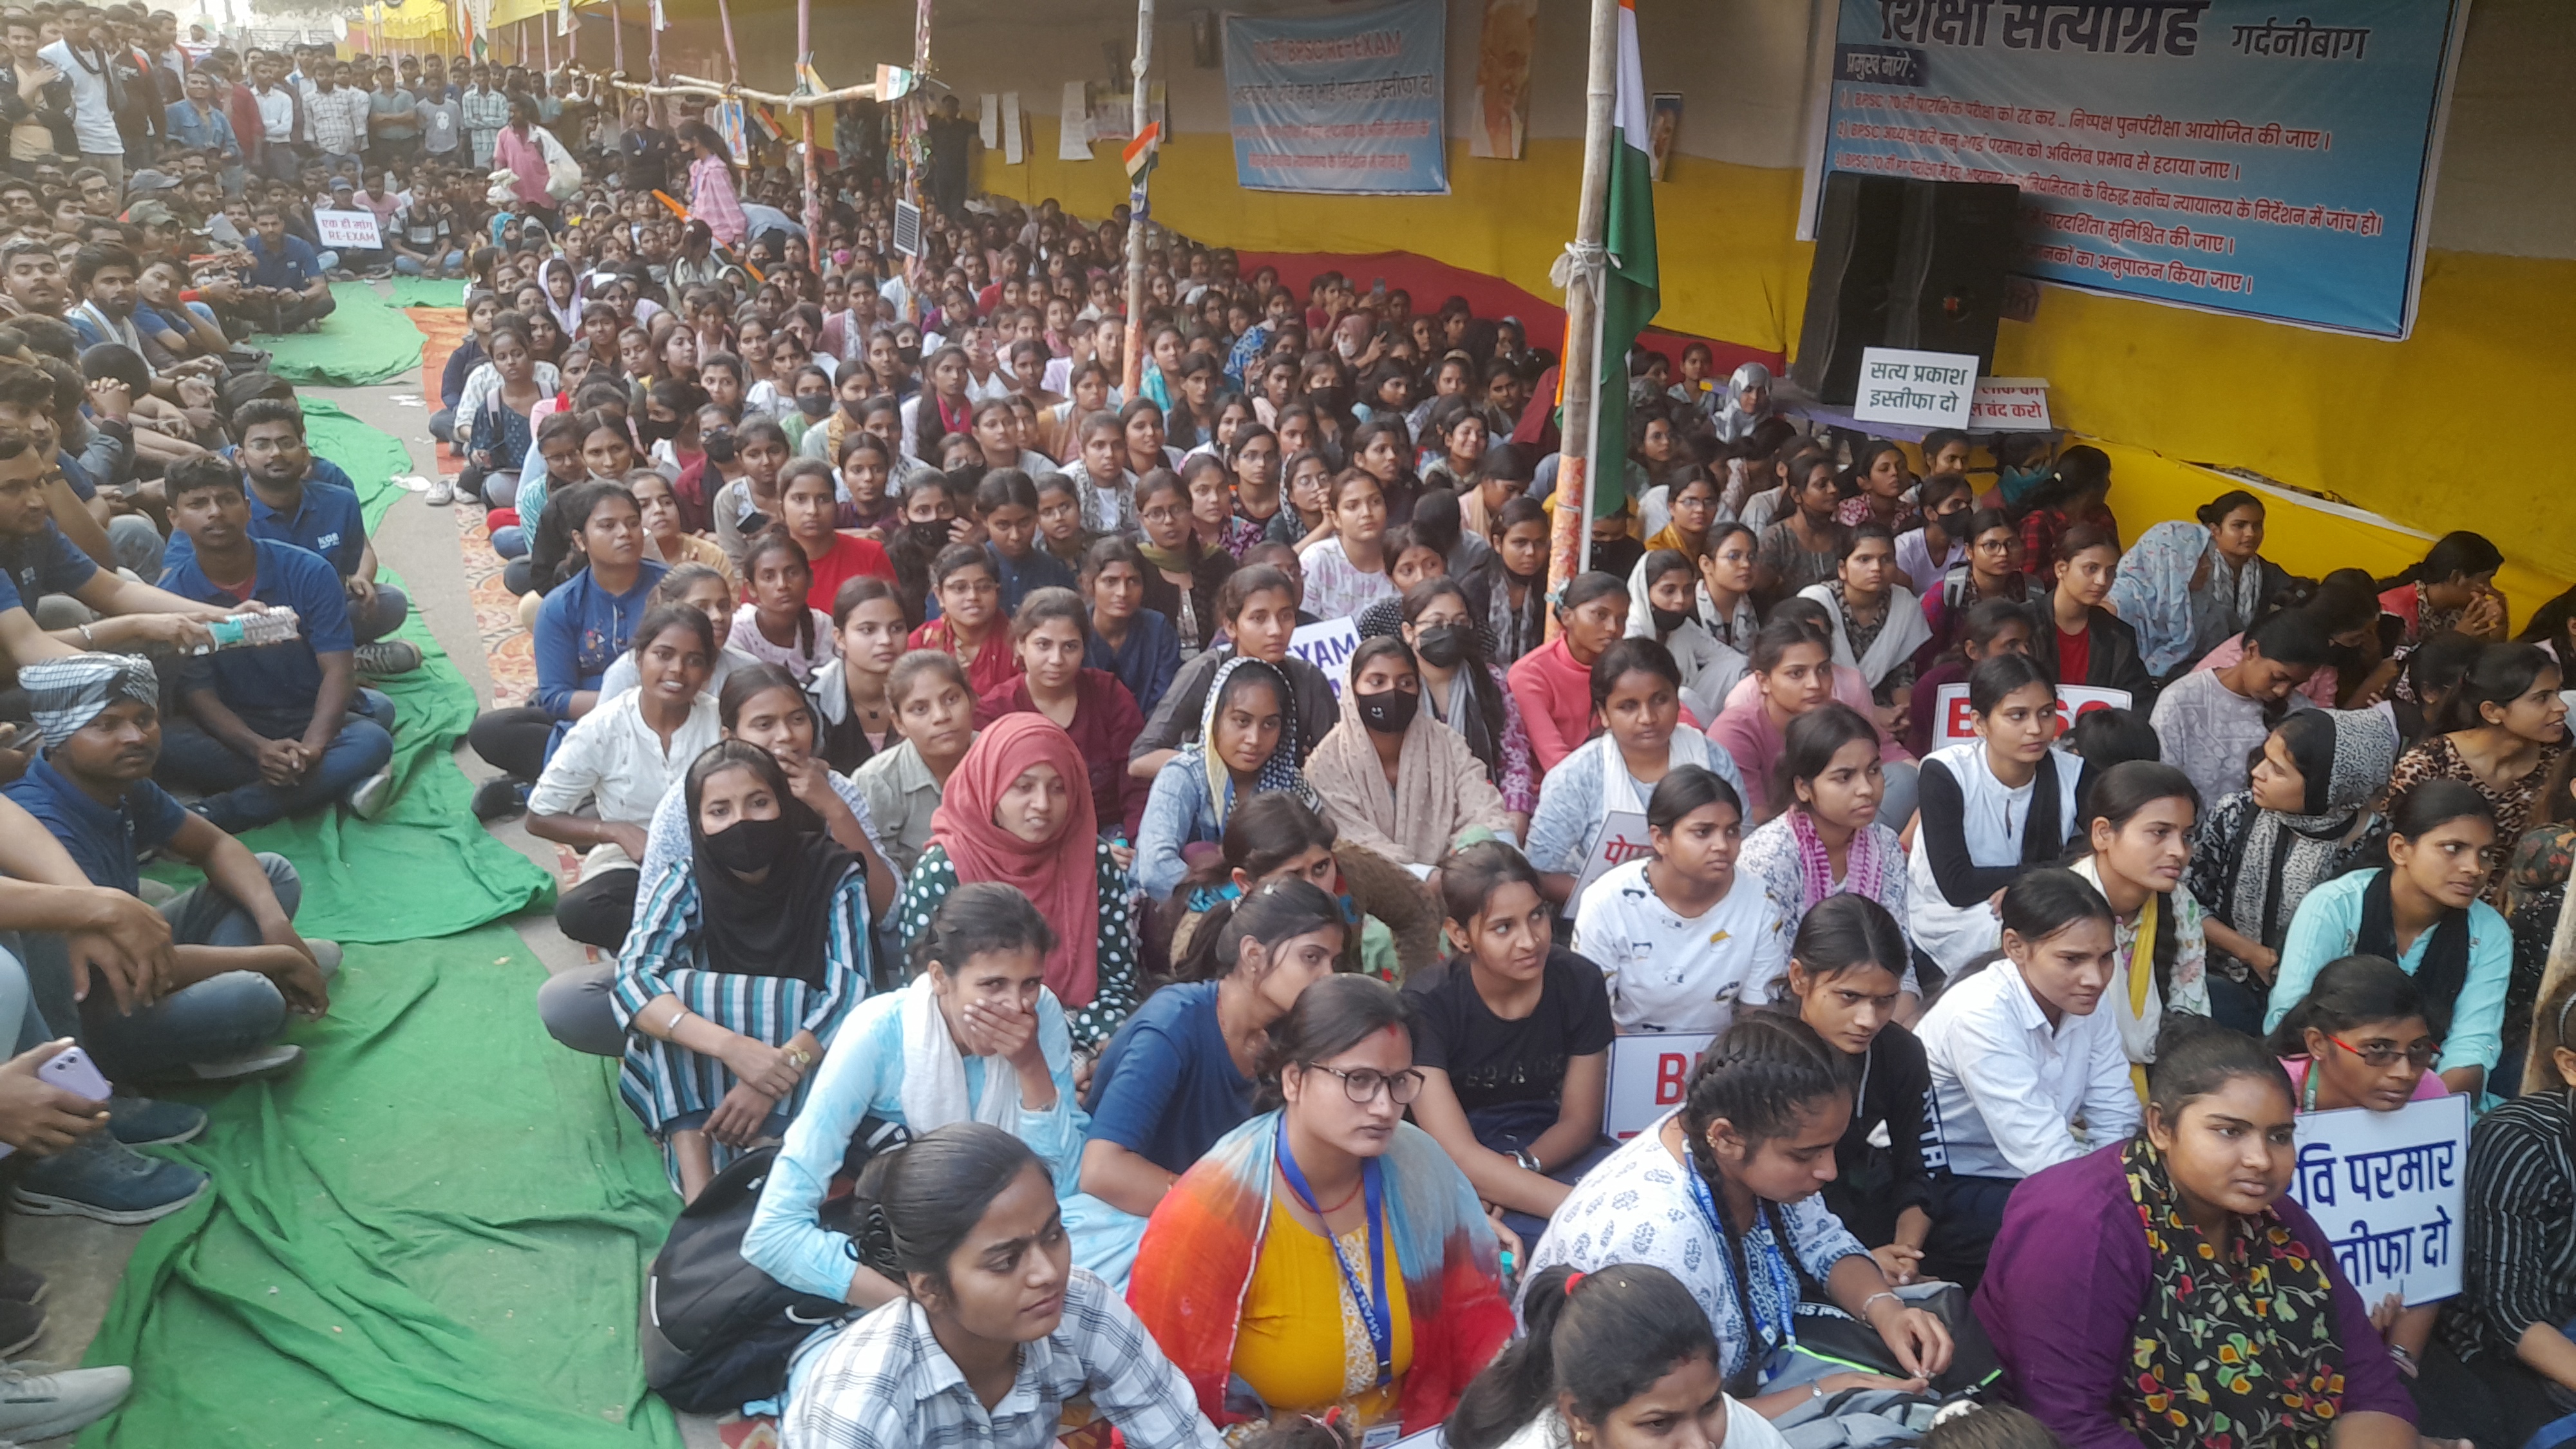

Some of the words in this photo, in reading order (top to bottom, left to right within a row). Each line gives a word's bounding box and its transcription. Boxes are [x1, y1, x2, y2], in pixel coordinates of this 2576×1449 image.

[2002, 0, 2210, 55] सत्याग्रह
[2232, 17, 2371, 59] गर्दनीबाग
[1847, 52, 1880, 79] प्रमुख
[1855, 92, 1882, 108] BPSC
[1965, 100, 1994, 120] परीक्षा
[1998, 103, 2014, 122] को
[2069, 108, 2113, 132] निष्पक्ष
[2117, 114, 2181, 138] पुनर्परीक्षा
[2185, 120, 2254, 144] आयोजित
[2258, 122, 2282, 146] की
[2286, 129, 2320, 149] जाए
[1851, 123, 1880, 139] BPSC
[1940, 132, 1959, 154] मनु
[2026, 139, 2042, 158] को
[2046, 142, 2094, 165] अविलंब
[2097, 150, 2134, 170] प्रभाव
[2137, 151, 2150, 171] से
[2153, 156, 2196, 176] हटाया
[2199, 160, 2230, 179] जाए
[2082, 180, 2094, 198] के
[2097, 180, 2130, 206] विरुद्ध
[2132, 186, 2172, 209] सर्वोच्च
[2173, 194, 2233, 216] न्यायालय
[2237, 197, 2252, 218] के
[2255, 198, 2306, 225] निर्देशन
[2309, 204, 2324, 227] में
[2327, 209, 2358, 231] जांच
[321, 219, 338, 228] एक
[341, 218, 351, 229] ही
[352, 219, 374, 230] मांग
[328, 231, 376, 242] RE-EXAM
[2108, 218, 2166, 243] सुनिश्चित
[2169, 225, 2190, 247] की
[2193, 233, 2224, 252] जाए
[2077, 251, 2095, 268] का
[2098, 254, 2165, 279] अनुपालन
[2168, 261, 2207, 286] किया
[2210, 271, 2242, 290] जाए
[1870, 362, 1911, 381] सत्य
[1913, 365, 1968, 386] प्रकाश
[1869, 386, 1936, 412] इस्तीफा
[1939, 391, 1960, 413] दो
[1985, 399, 2008, 417] बंद
[2009, 400, 2042, 418] करो
[1288, 633, 1356, 668] XAM
[2344, 1139, 2457, 1202] परमार
[2420, 1204, 2452, 1268] दो
